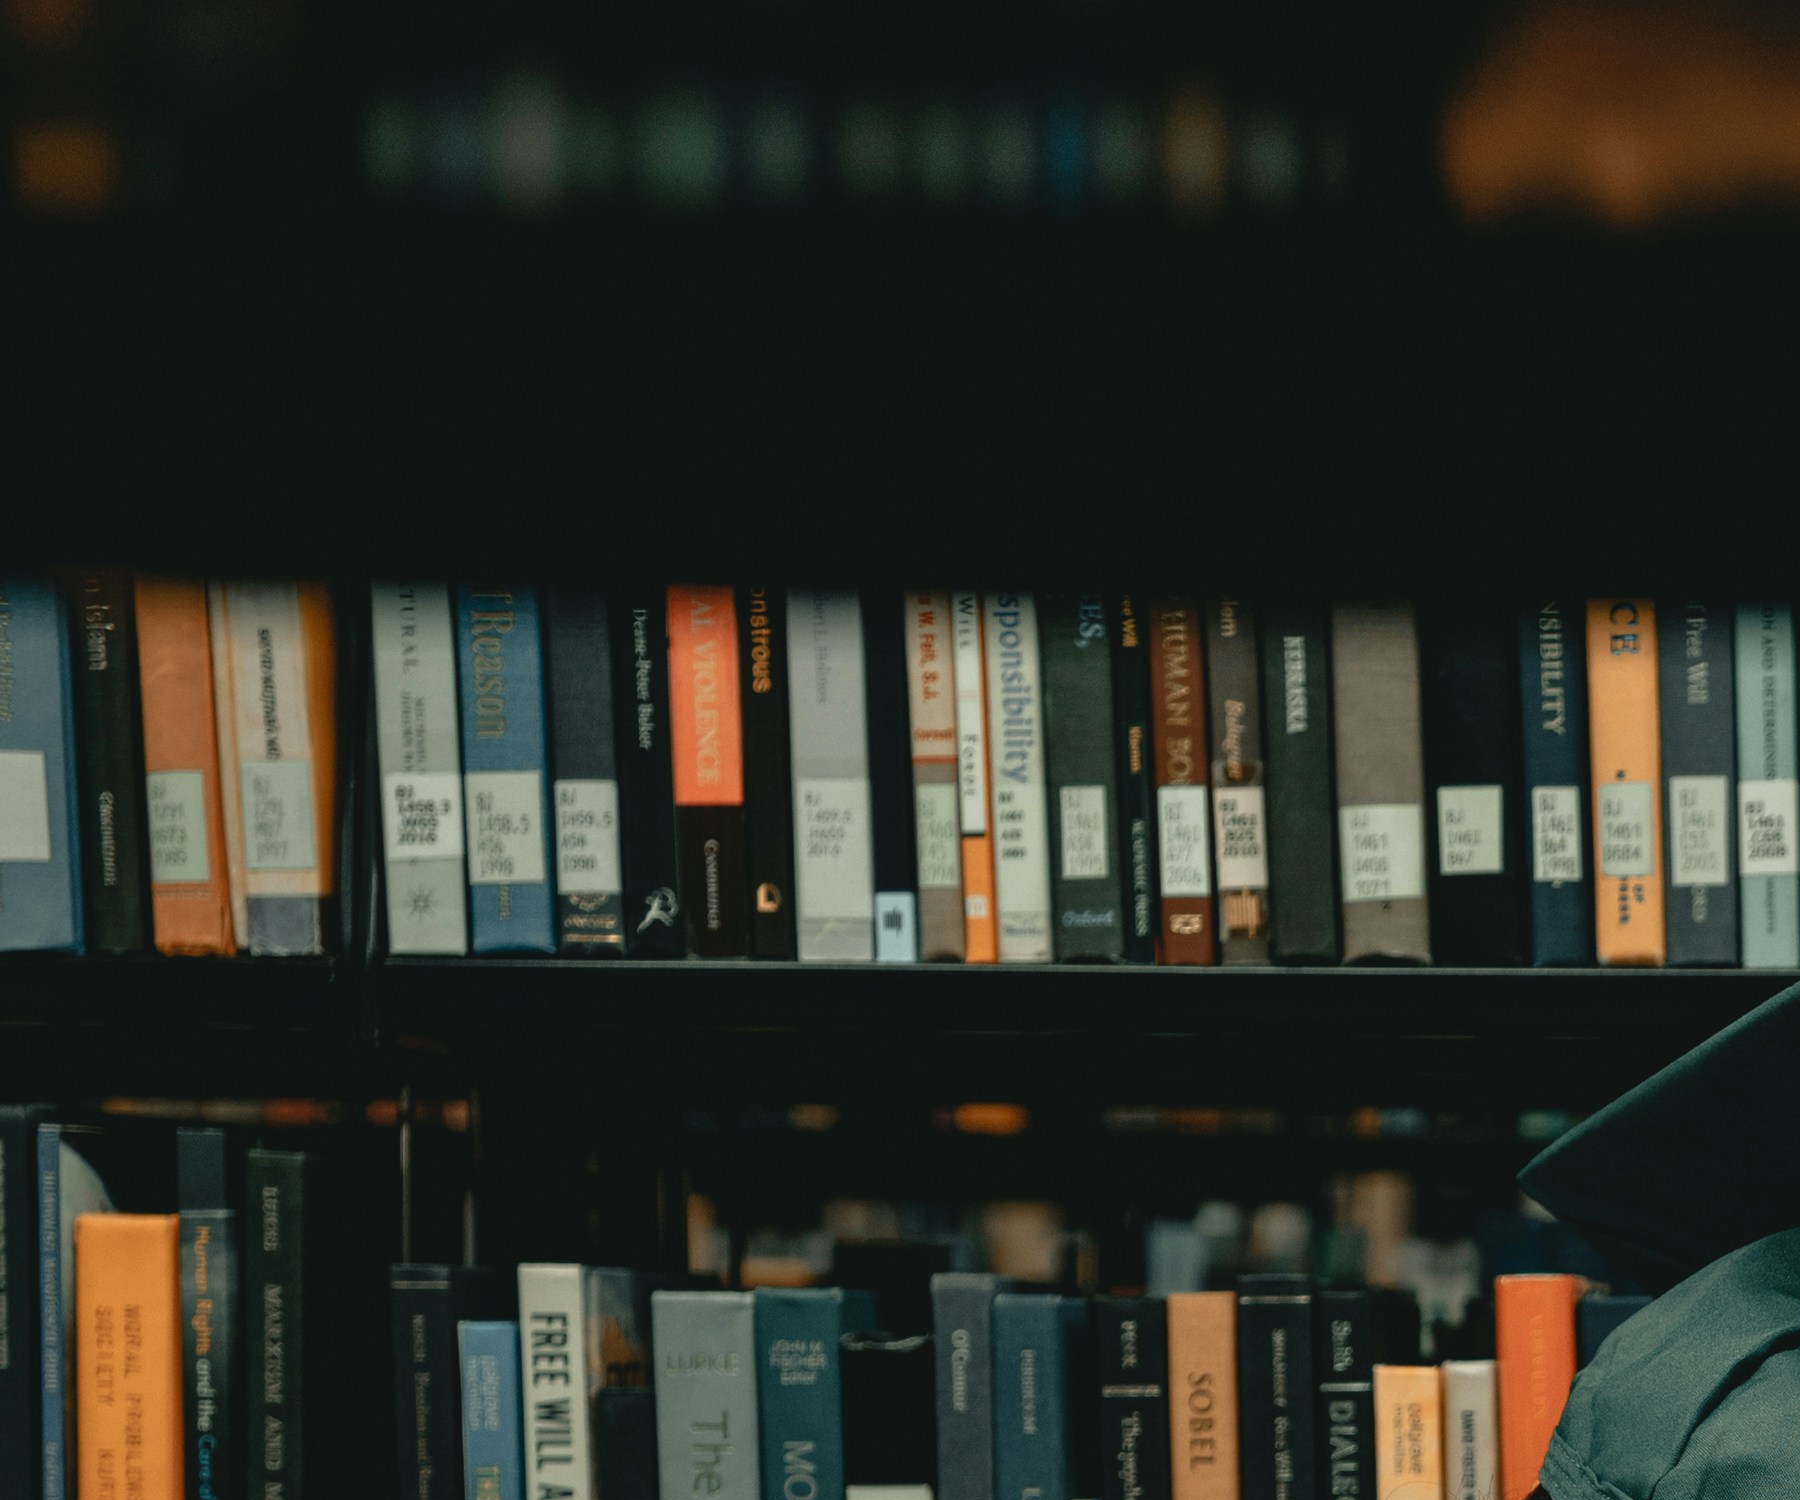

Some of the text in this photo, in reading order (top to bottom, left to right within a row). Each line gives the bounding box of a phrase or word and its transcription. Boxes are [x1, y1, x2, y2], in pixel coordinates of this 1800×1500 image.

[86, 603, 116, 671] Islam
[633, 608, 650, 702] Deane-Peter
[1161, 610, 1194, 726] HUMAN
[1685, 616, 1710, 704] Free Will
[470, 611, 516, 740] Reason
[1282, 635, 1308, 736] NEBRASKA
[692, 640, 722, 787] VIOLENCE
[477, 815, 530, 835] 1458.5
[1540, 813, 1575, 835] 1461
[1602, 797, 1624, 818] BJ
[1604, 820, 1644, 841] 1461
[478, 855, 515, 877] 1998
[195, 1224, 212, 1296] Human
[94, 1305, 115, 1407] SOCIETY
[124, 1304, 144, 1378] MORAL
[191, 1298, 215, 1355] Rights
[262, 1283, 285, 1405] MARXISM
[530, 1313, 570, 1386] FREE
[951, 1327, 971, 1415] O'Connor
[197, 1433, 219, 1484] Care
[263, 1414, 285, 1471] AND
[534, 1399, 575, 1470] WILL
[689, 1408, 734, 1496] The
[1186, 1371, 1217, 1472] SOBEL
[1406, 1402, 1426, 1477] palgrave
[1460, 1409, 1480, 1492] DAVID FOSTER
